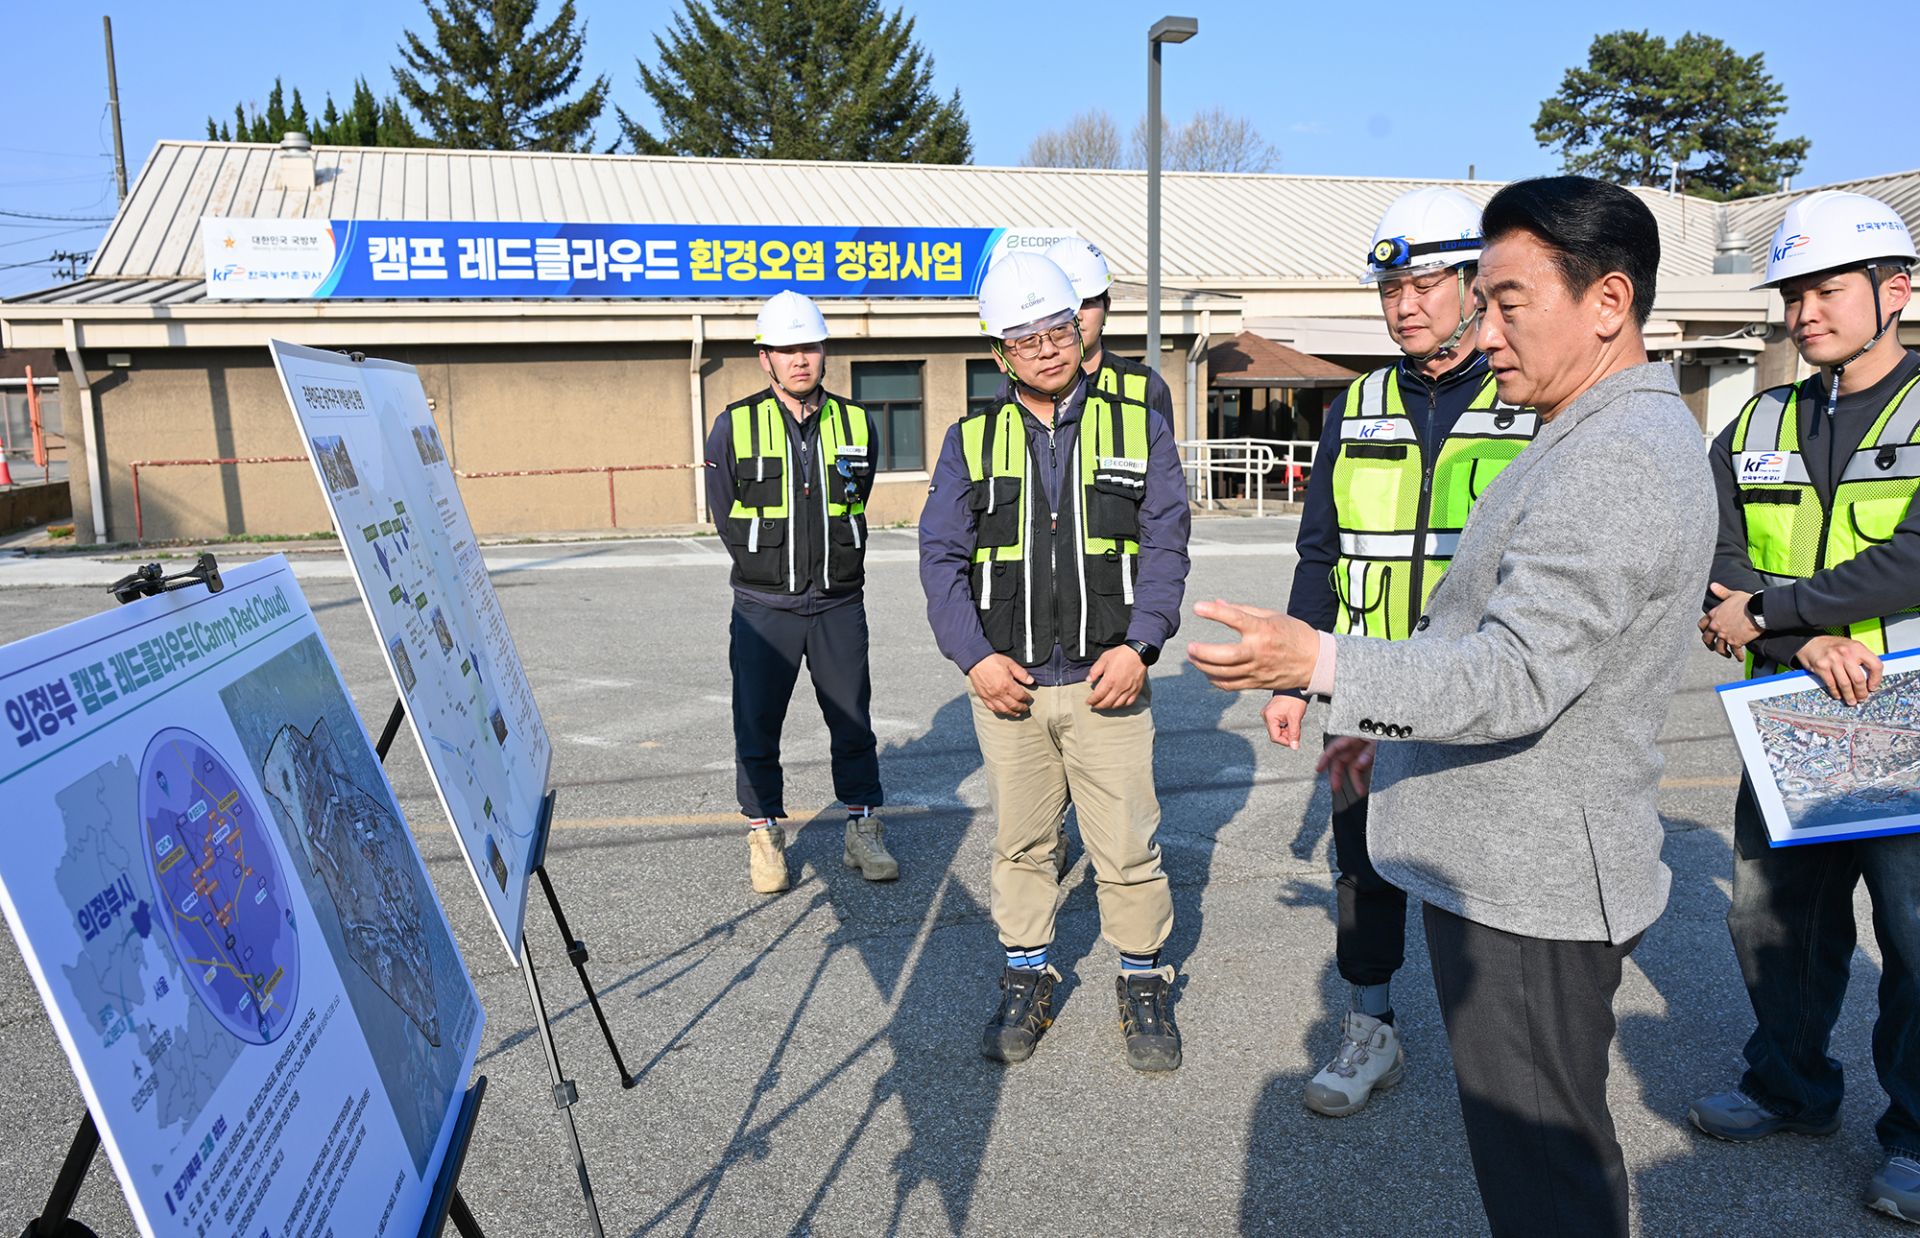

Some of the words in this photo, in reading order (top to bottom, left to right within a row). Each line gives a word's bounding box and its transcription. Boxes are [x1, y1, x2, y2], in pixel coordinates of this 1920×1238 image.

[251, 235, 288, 246] 대한민국
[291, 235, 319, 246] 국방부
[1439, 240, 1457, 251] LED
[367, 235, 449, 283] 캠프
[458, 236, 679, 283] 레드클라우드
[688, 237, 825, 283] 환경오염
[834, 239, 963, 284] 정화사업
[248, 270, 322, 280] 한국농어촌공사
[1113, 459, 1145, 469] ECORBIT
[6, 680, 75, 746] 의정부
[70, 663, 117, 714] 캠프
[109, 619, 235, 693] 레드클라우드(Camp
[229, 600, 259, 634] Red
[253, 586, 290, 623] Cloud)
[78, 875, 135, 941] 의정부시
[154, 976, 169, 1000] 서울
[173, 1153, 201, 1200] 경기북부
